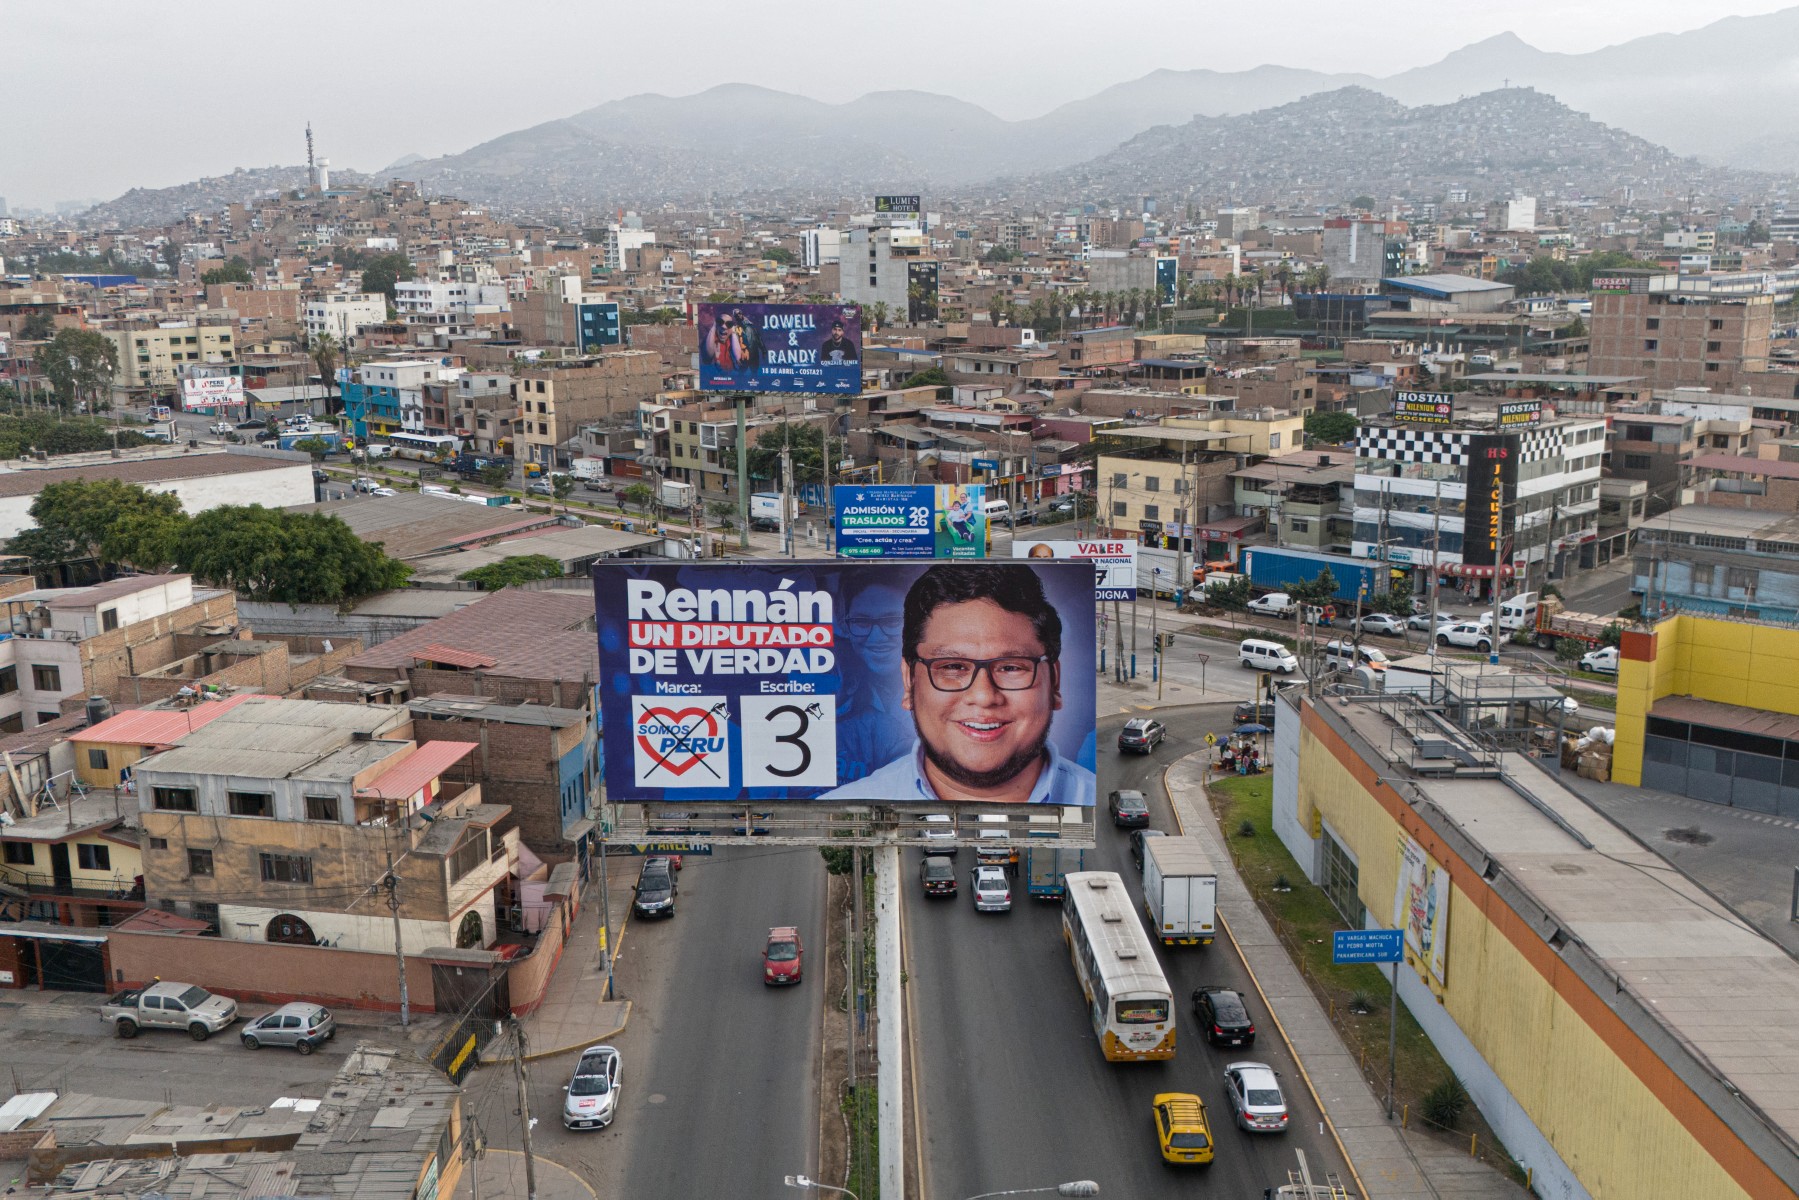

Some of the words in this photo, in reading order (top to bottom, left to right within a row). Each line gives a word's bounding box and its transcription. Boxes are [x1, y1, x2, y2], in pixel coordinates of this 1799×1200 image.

[890, 197, 918, 205] LUMI'S
[1594, 276, 1629, 285] HOSTAL
[762, 313, 816, 330] JOWELL
[788, 331, 799, 347] &
[768, 349, 817, 364] RANDY
[800, 368, 823, 376] COSTA21
[1398, 392, 1451, 404] HOSTAL
[1406, 403, 1435, 412] MILENIUM
[1502, 404, 1541, 414] HOSTAL
[1395, 415, 1450, 424] COCHERA
[1502, 414, 1530, 423] MILENIUM
[843, 505, 896, 514] ADMISIÓN
[843, 517, 905, 525] TRASLADOS
[1078, 544, 1124, 554] VALER
[627, 578, 833, 623] Rennán
[1096, 591, 1129, 600] DIGNA
[631, 624, 674, 646] UN
[682, 624, 831, 646] DIPUTADO
[629, 648, 678, 674] DE
[684, 648, 835, 674] VERDAD
[656, 681, 702, 694] Marca:
[760, 681, 815, 693] Escribe:
[638, 724, 690, 735] SOMOS
[660, 737, 725, 753] PERU
[764, 704, 812, 778] 3
